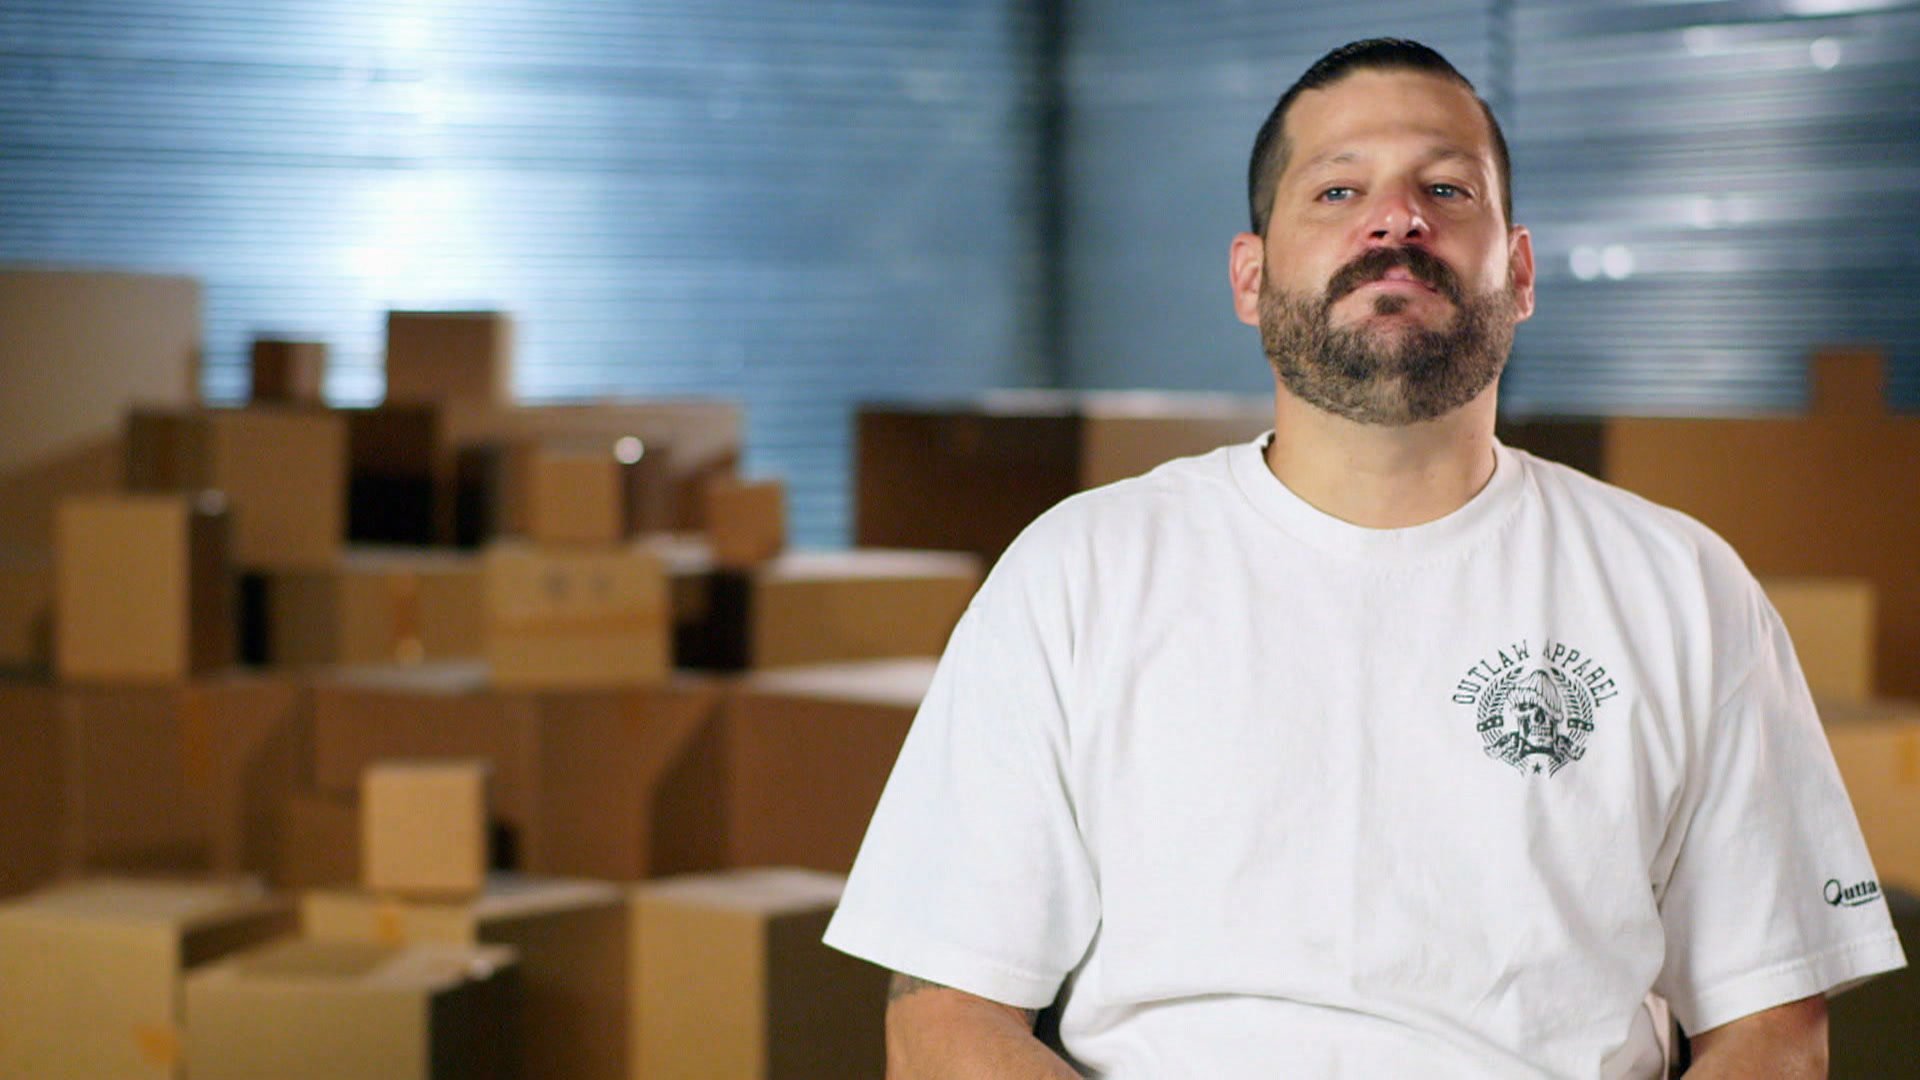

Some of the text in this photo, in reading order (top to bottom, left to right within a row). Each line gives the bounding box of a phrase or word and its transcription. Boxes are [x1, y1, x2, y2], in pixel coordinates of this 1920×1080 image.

[1452, 638, 1618, 707] OUTLAW APPAREL
[1823, 879, 1878, 907] Outla
